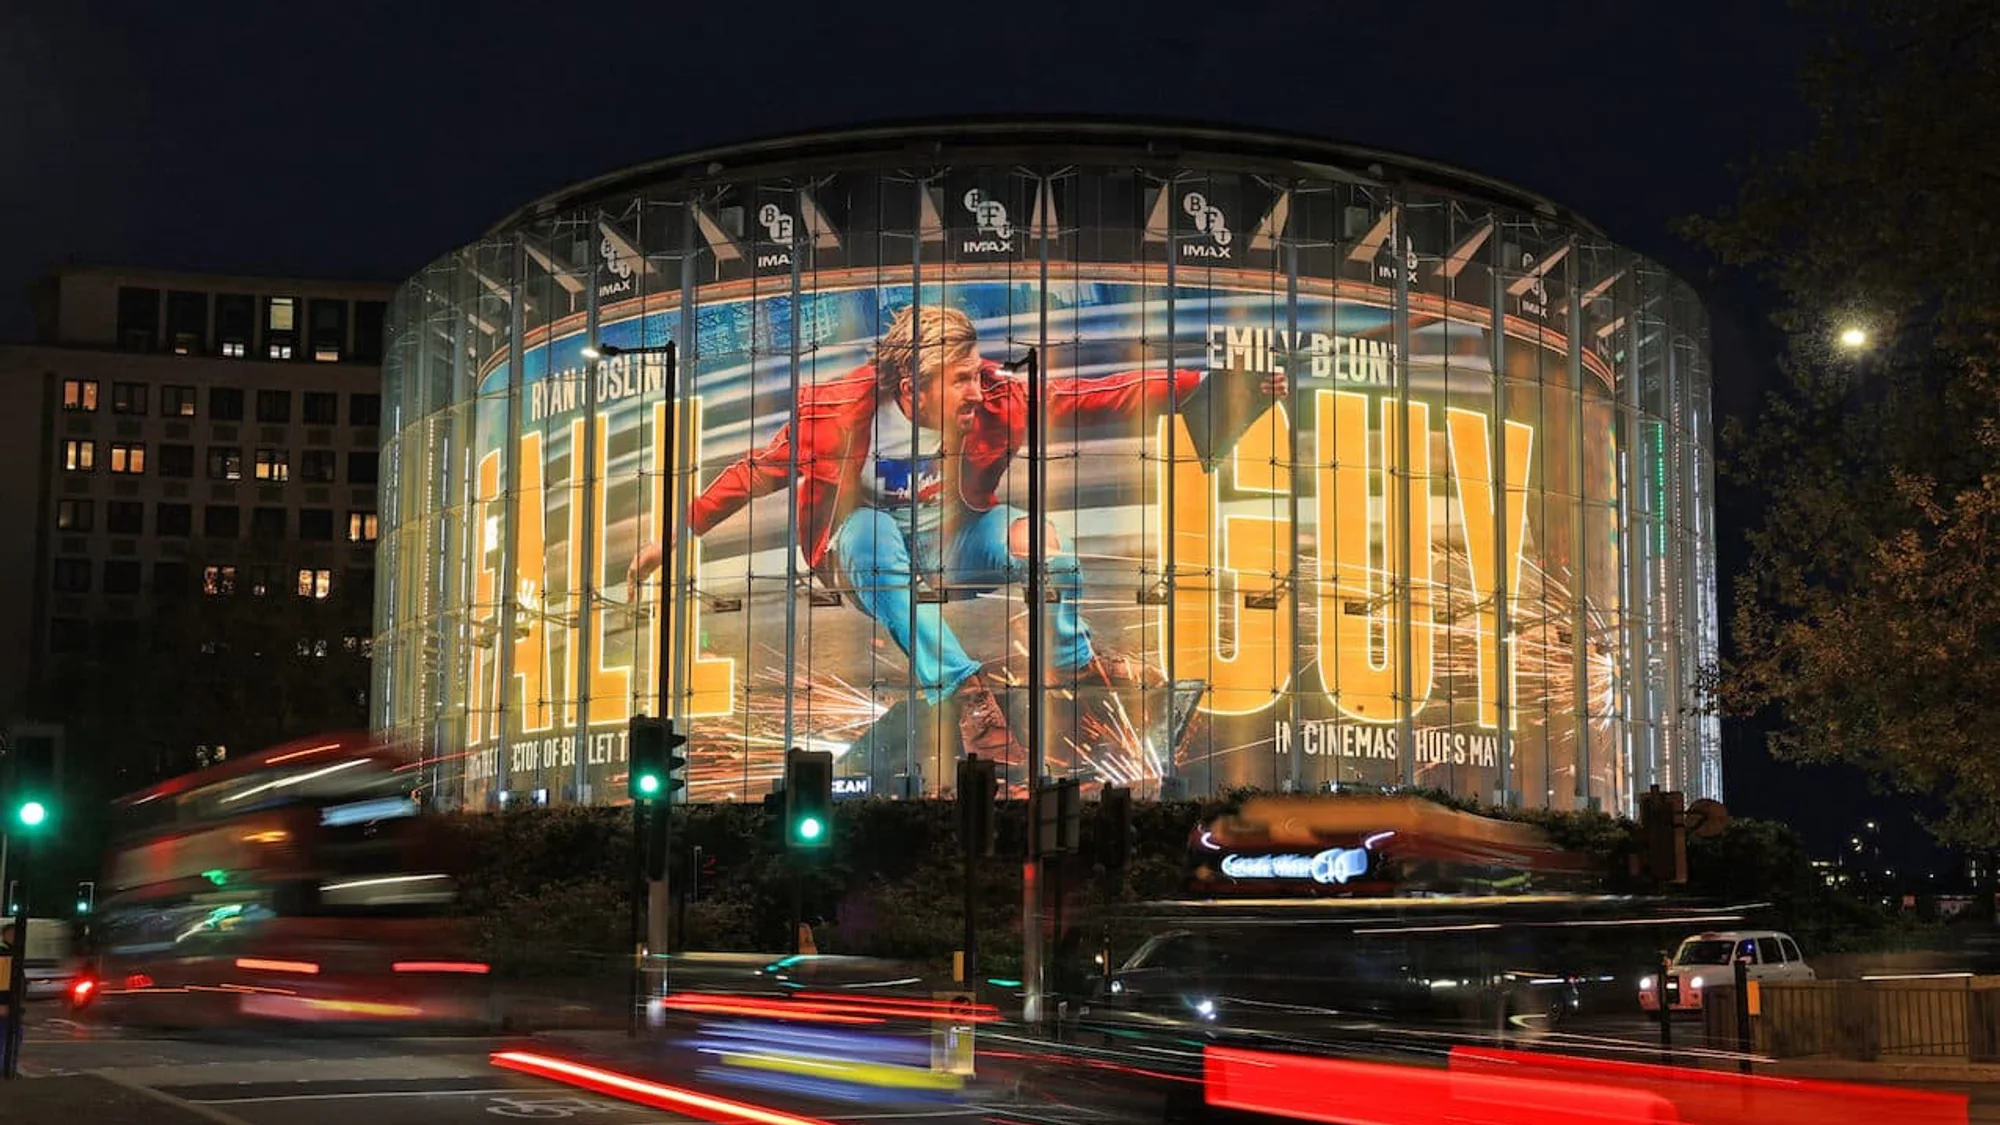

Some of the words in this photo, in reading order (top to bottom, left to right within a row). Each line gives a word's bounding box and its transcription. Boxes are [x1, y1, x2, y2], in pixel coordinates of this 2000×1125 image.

[964, 241, 1014, 252] IMAX
[1183, 245, 1231, 258] IMAX
[758, 254, 793, 268] IMA
[1379, 266, 1418, 283] IMX
[599, 280, 630, 297] IMAX
[532, 367, 577, 422] RYAN
[581, 347, 681, 407] OSLIN
[469, 396, 735, 746] FALL
[1157, 389, 1534, 731] GUY
[544, 737, 560, 768] OF
[562, 732, 614, 768] BLET
[1303, 721, 1399, 761] CINEMAS
[1412, 728, 1466, 766] HURS
